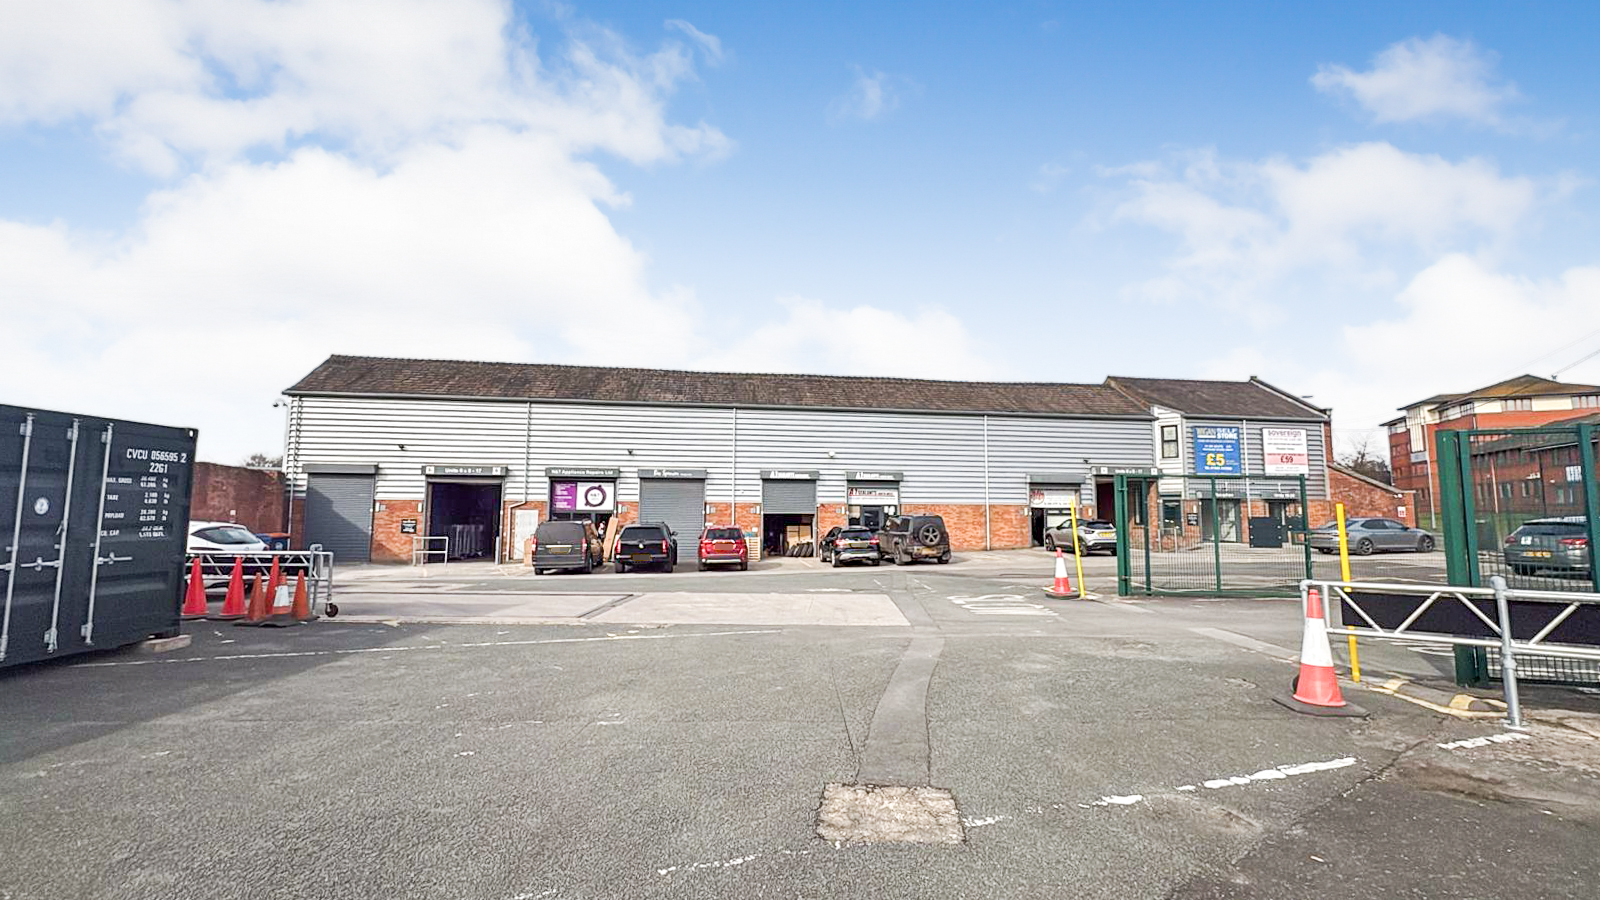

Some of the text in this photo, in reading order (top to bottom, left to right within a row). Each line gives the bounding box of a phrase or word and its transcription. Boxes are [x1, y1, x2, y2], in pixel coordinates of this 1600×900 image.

[1267, 429, 1302, 438] sovereign
[126, 448, 187, 463] CVCU 056595 2
[1206, 452, 1226, 467] £5
[149, 462, 168, 474] 22G1
